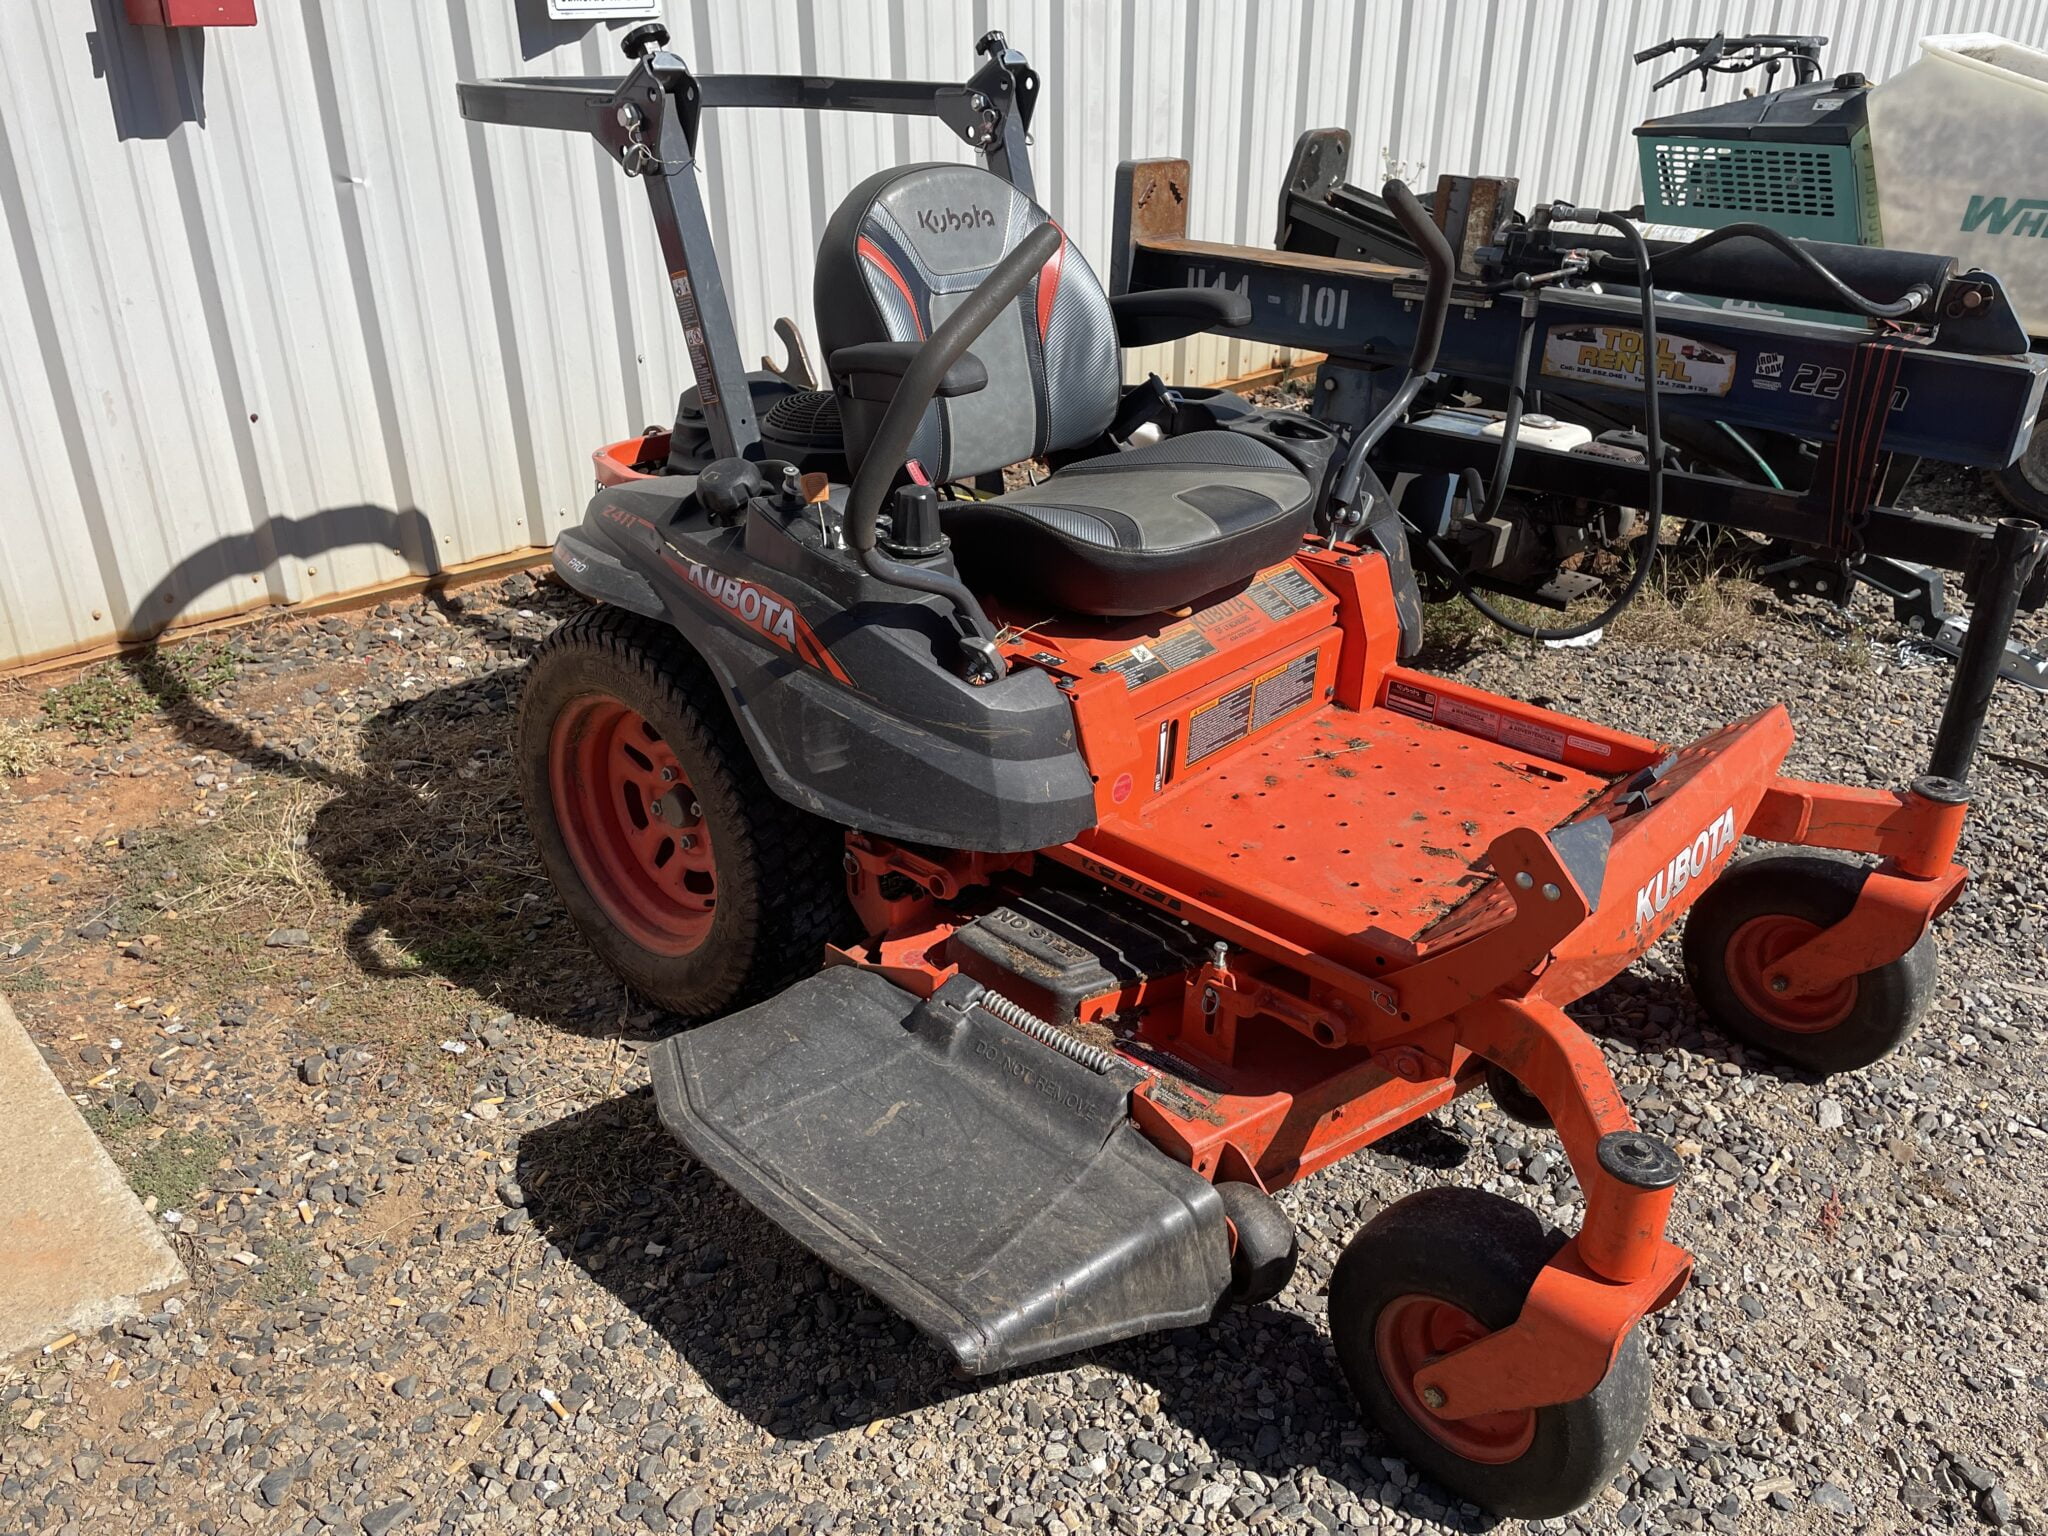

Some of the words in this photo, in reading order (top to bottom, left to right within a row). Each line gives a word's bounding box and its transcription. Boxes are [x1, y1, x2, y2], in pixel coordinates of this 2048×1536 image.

[917, 204, 995, 234] Kubota
[1602, 328, 1676, 361] TOL
[1757, 352, 1778, 366] IRON
[1577, 345, 1692, 383] RENAL
[1765, 363, 1784, 375] OAK
[1789, 363, 1847, 400] 22
[567, 558, 587, 573] PRO
[688, 563, 797, 645] KUBOTA
[1635, 806, 1735, 934] KUBOTA
[993, 908, 1029, 929] NO
[974, 1040, 998, 1062] DO
[1002, 1056, 1036, 1084] NOT
[1035, 1075, 1099, 1123] REMOVE
